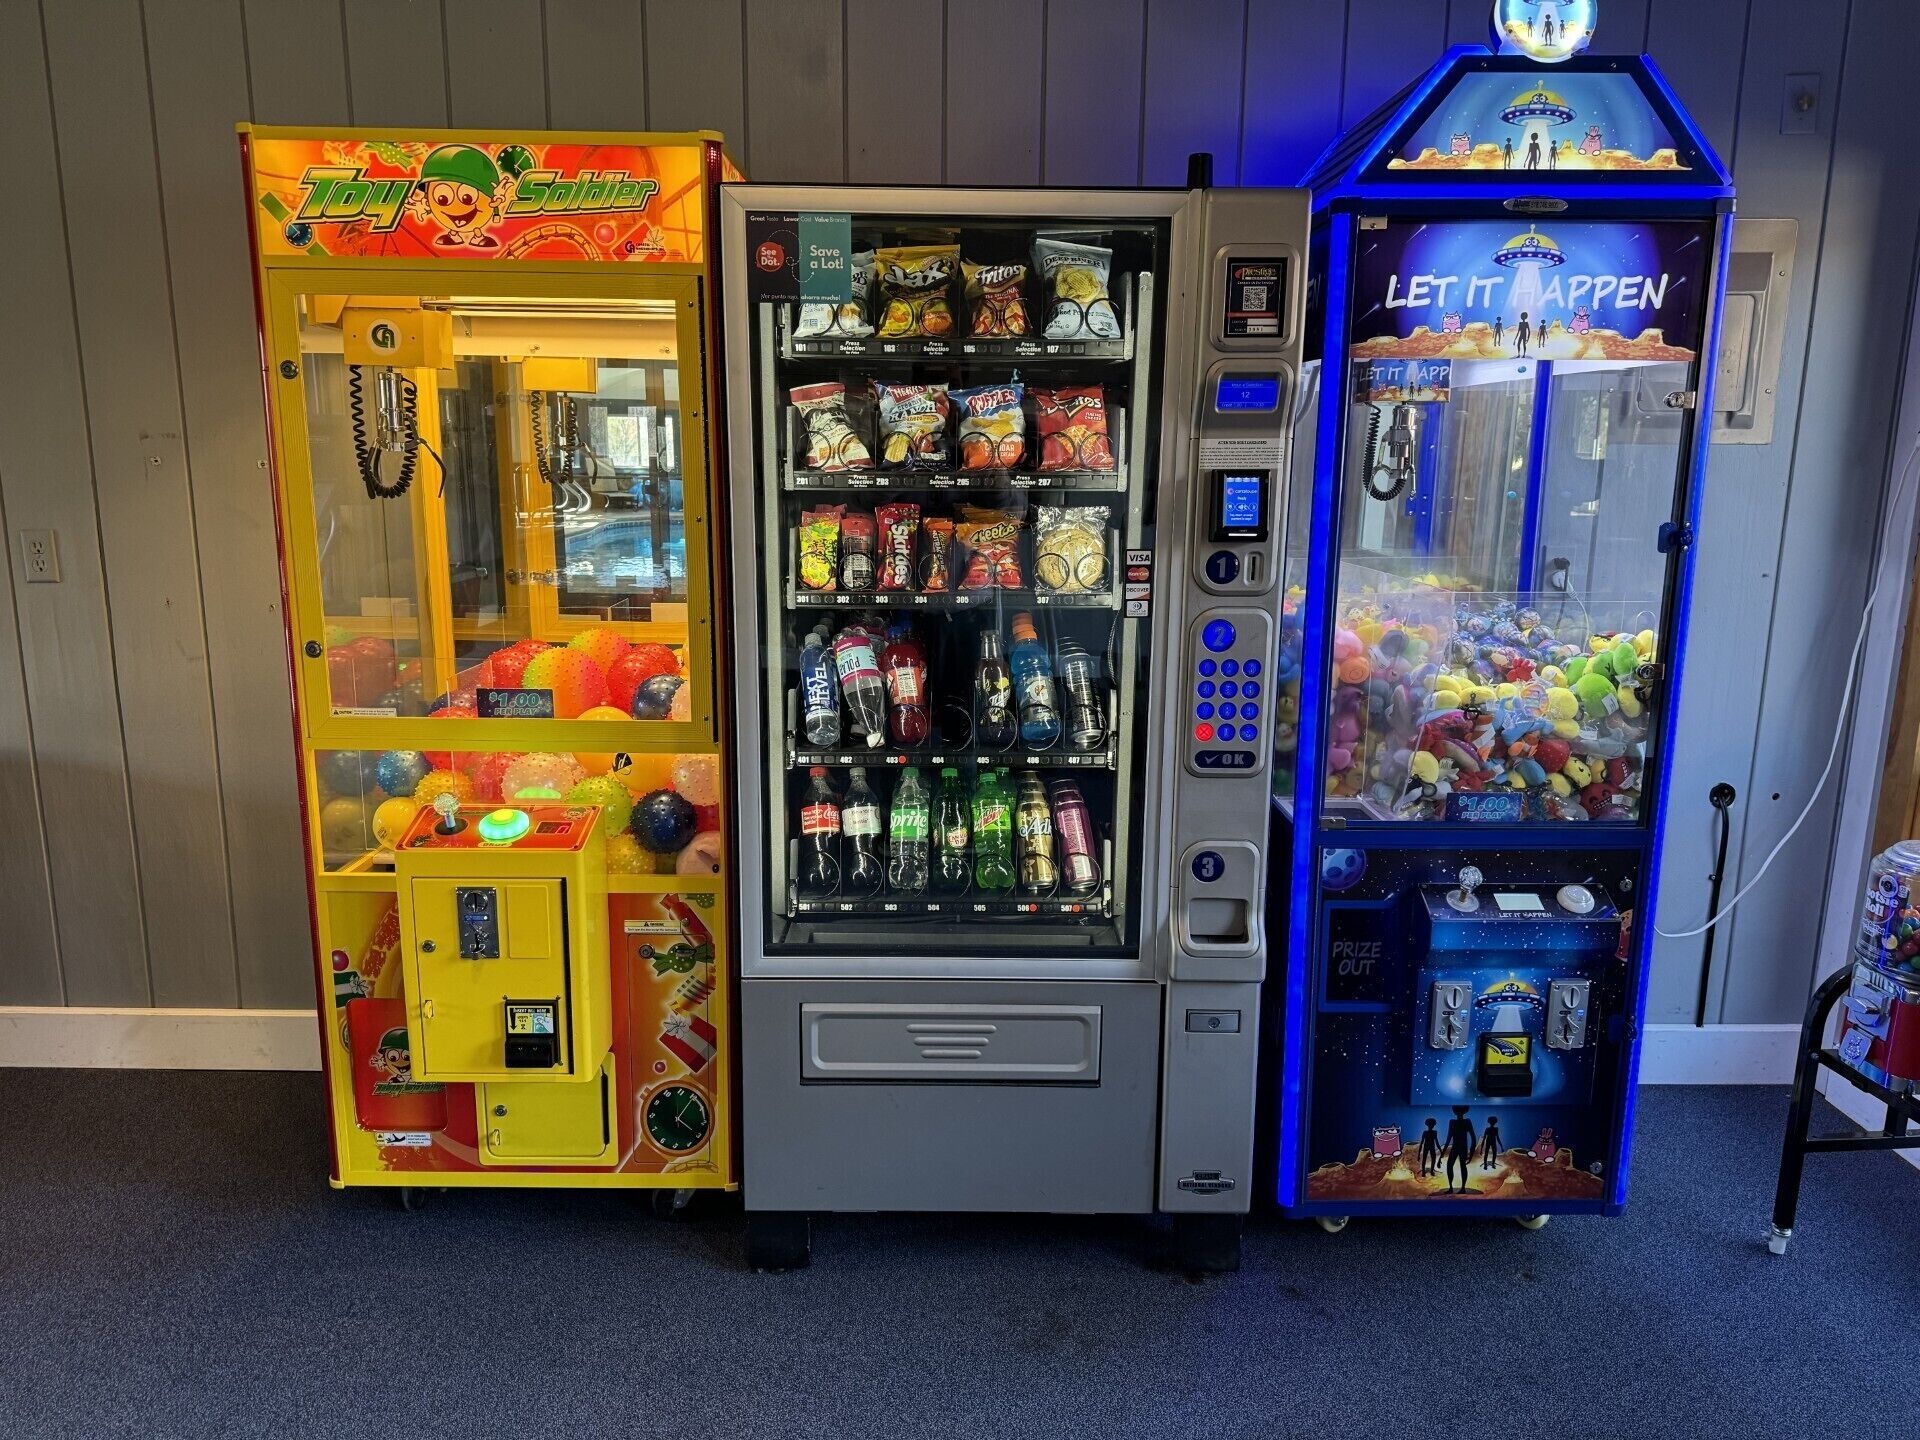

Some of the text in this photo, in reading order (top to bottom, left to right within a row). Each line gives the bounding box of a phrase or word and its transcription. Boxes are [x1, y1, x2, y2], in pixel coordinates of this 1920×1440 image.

[297, 168, 658, 231] Toy Soldier
[761, 247, 777, 256] See
[810, 245, 840, 256] Save
[761, 257, 780, 266] Dot.
[810, 257, 844, 269] a Lot!
[1045, 256, 1101, 267] DEEP RIVER
[975, 265, 1020, 286] Fritos
[1385, 272, 1669, 311] LET IT HAPPEN
[795, 344, 806, 352] 101
[1387, 366, 1404, 381] IT
[1241, 391, 1250, 399] 12
[966, 389, 1018, 416] RUFFLES
[876, 478, 889, 486] 203
[957, 478, 969, 486] 205
[1038, 478, 1051, 486] 207
[970, 522, 1017, 544] Cheetos
[1129, 554, 1150, 562] VISA
[1216, 556, 1226, 578] 1
[797, 595, 809, 603] 301
[837, 595, 850, 603] 302
[875, 595, 888, 603] 303
[915, 595, 927, 603] 304
[1037, 596, 1049, 604] 307
[1213, 627, 1225, 646] 2
[488, 692, 540, 707] $1.00
[494, 707, 538, 716] PER PLAY
[1222, 753, 1244, 765] OK
[1458, 795, 1510, 811] $1.00
[891, 810, 927, 828] Sprite
[1461, 811, 1507, 819] PER PLAY
[1201, 857, 1214, 877] 3
[1865, 897, 1885, 917] Roll
[1333, 942, 1382, 958] PRIZE
[1338, 959, 1375, 976] OUT
